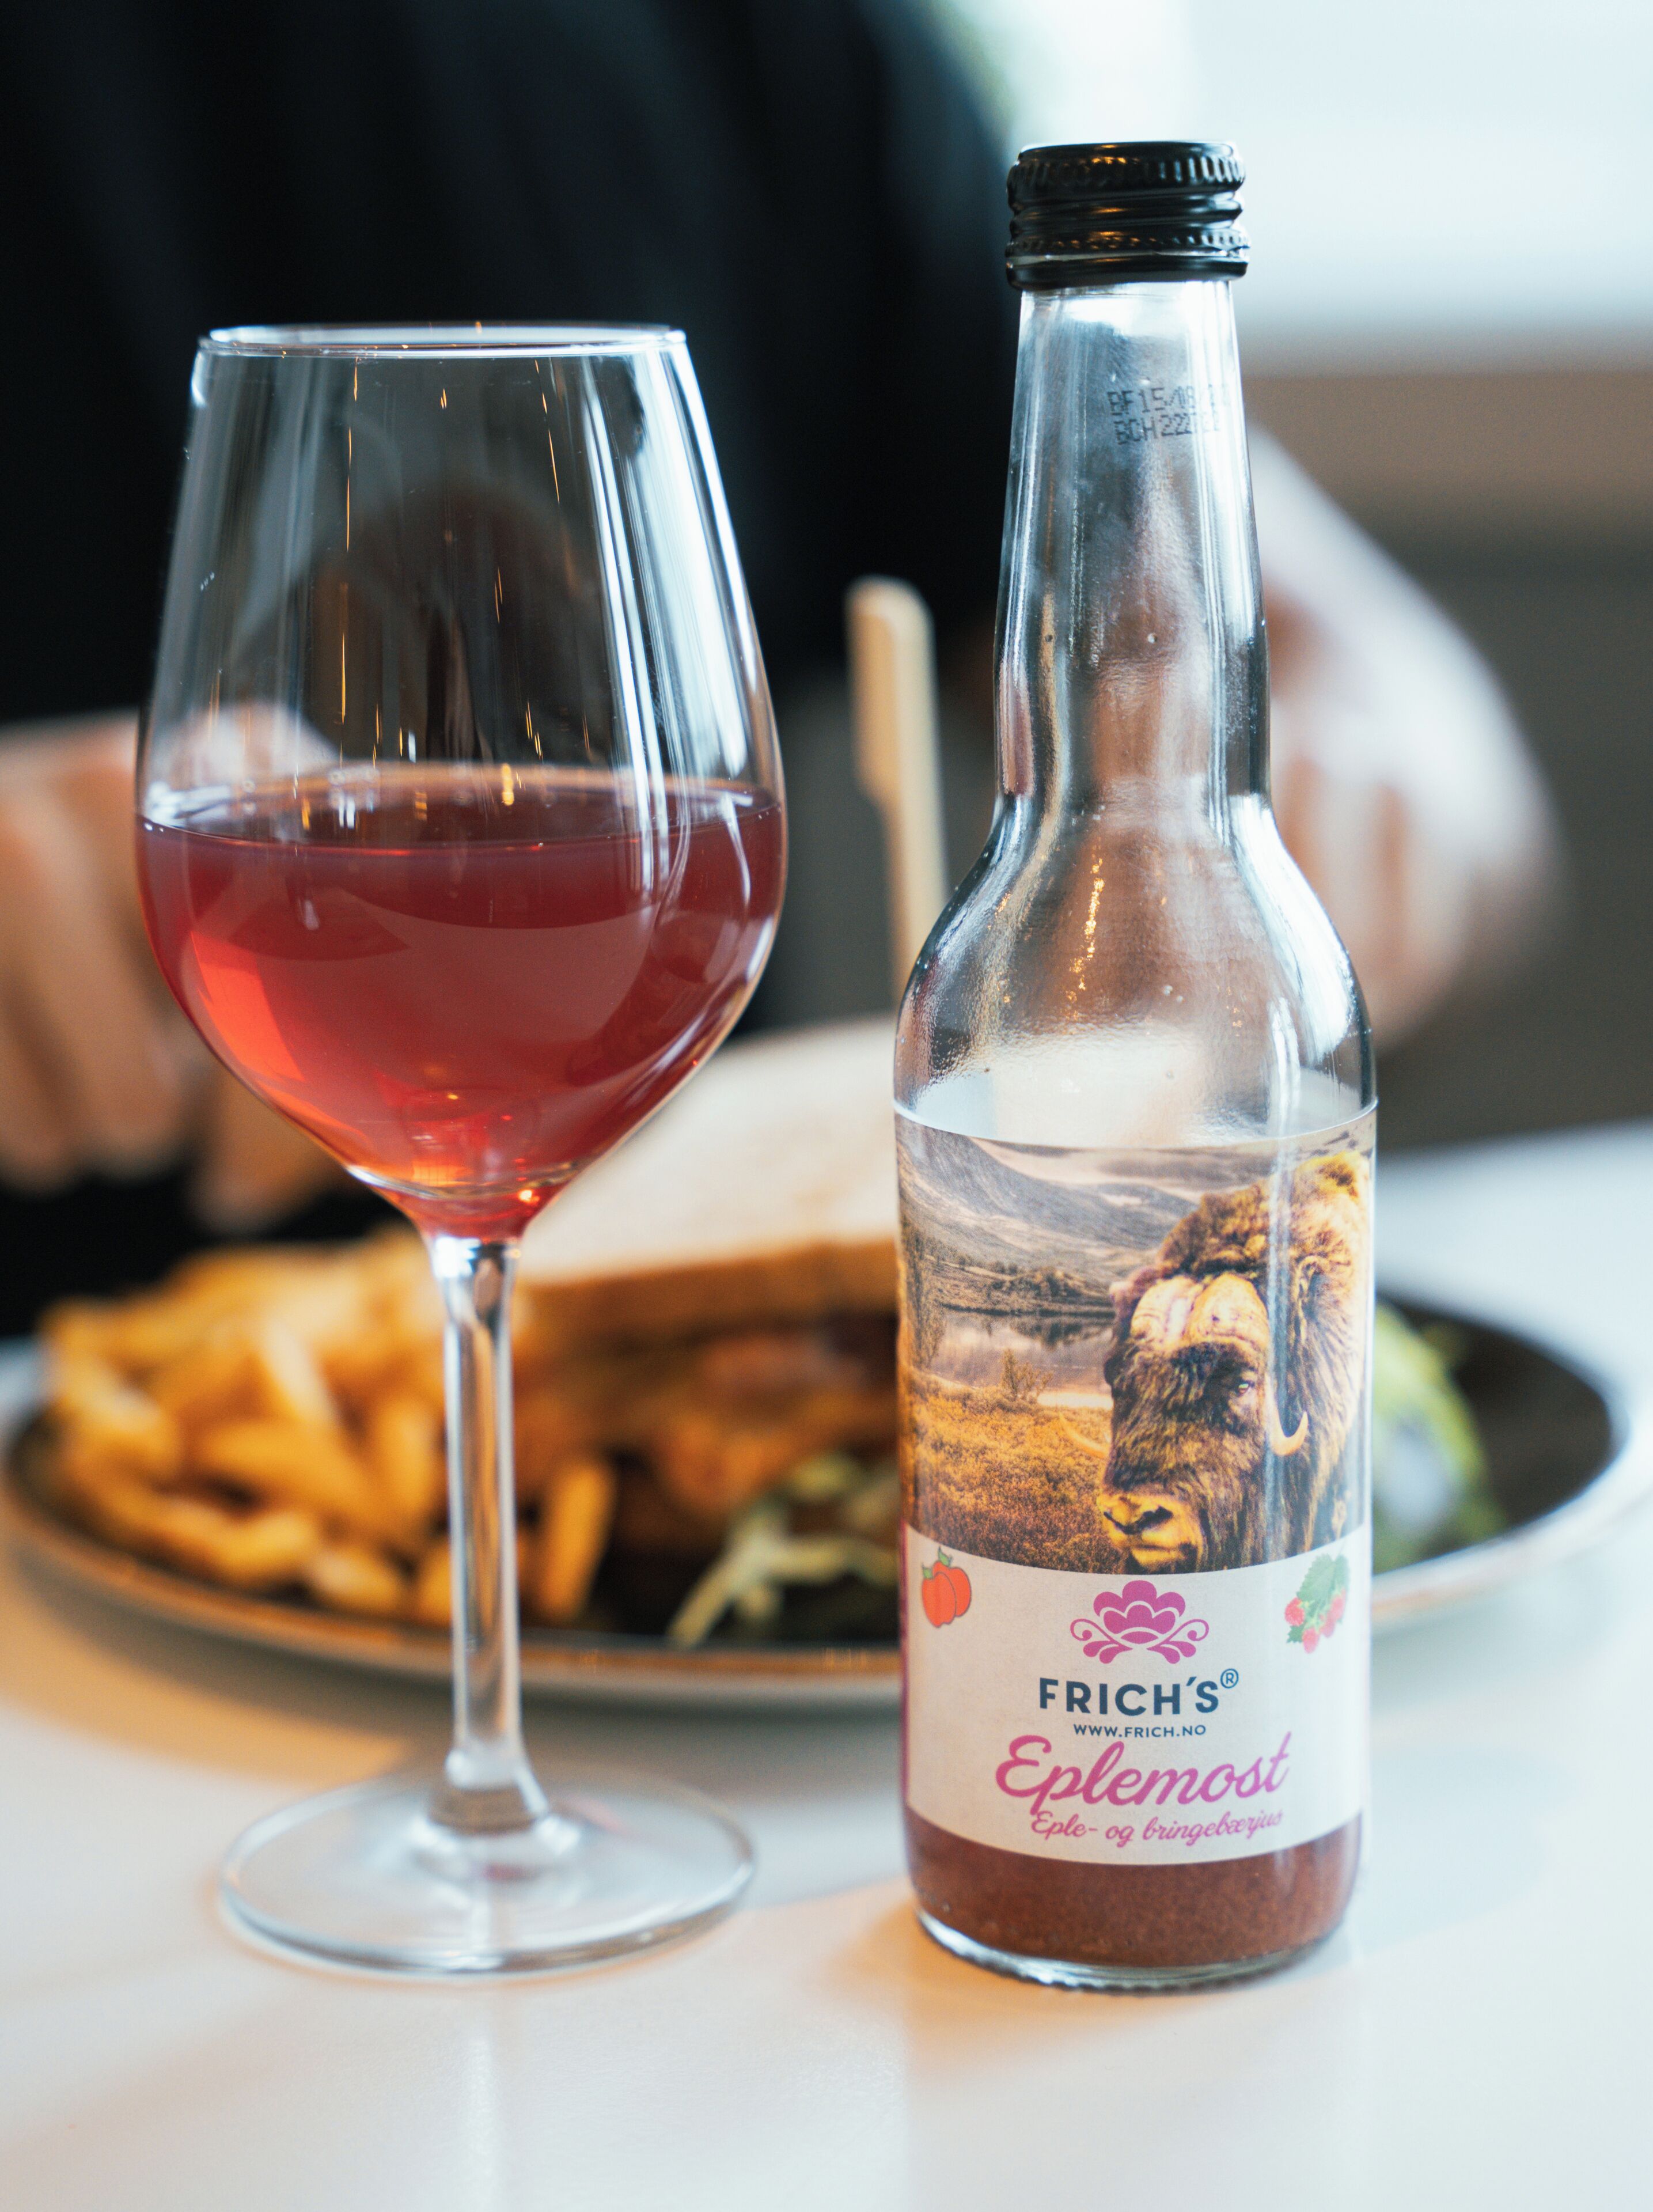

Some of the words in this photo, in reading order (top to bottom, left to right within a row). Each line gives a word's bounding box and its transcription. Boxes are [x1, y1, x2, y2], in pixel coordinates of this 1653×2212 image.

[1073, 1724, 1207, 1738] WWW.FRICH.NO
[995, 1732, 1292, 1816] Eplemost
[1031, 1810, 1098, 1840] Eple-
[1105, 1824, 1135, 1848] og
[1142, 1809, 1283, 1846] bringebærjus
